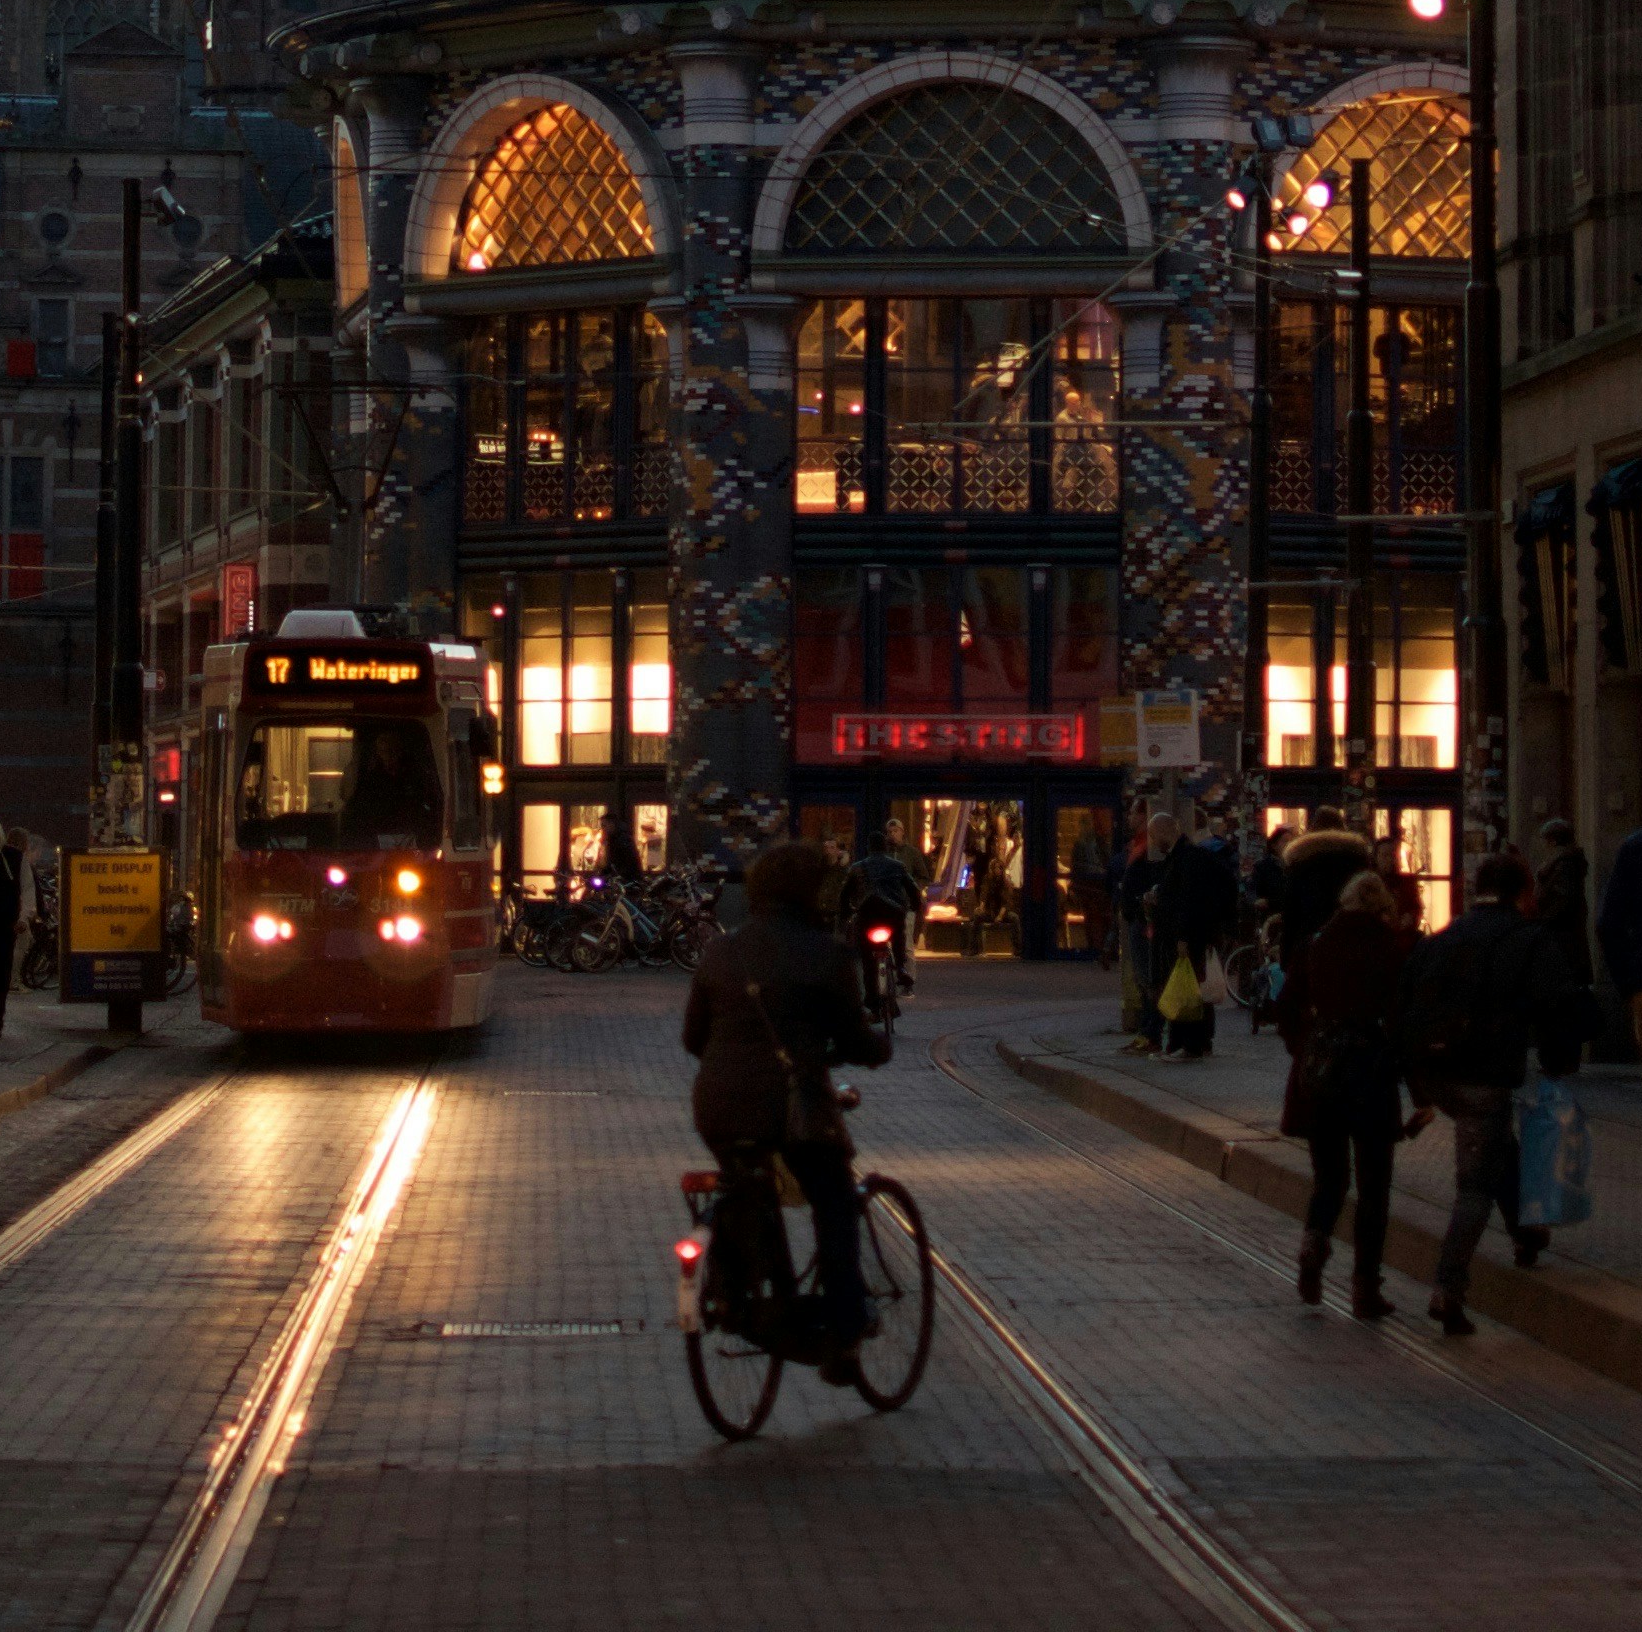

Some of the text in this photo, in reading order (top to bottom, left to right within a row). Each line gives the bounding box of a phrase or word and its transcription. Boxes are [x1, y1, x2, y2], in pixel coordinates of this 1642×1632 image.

[266, 656, 291, 684] 17
[844, 722, 1070, 749] THE STING
[80, 862, 153, 874] DEZE DISPLAY
